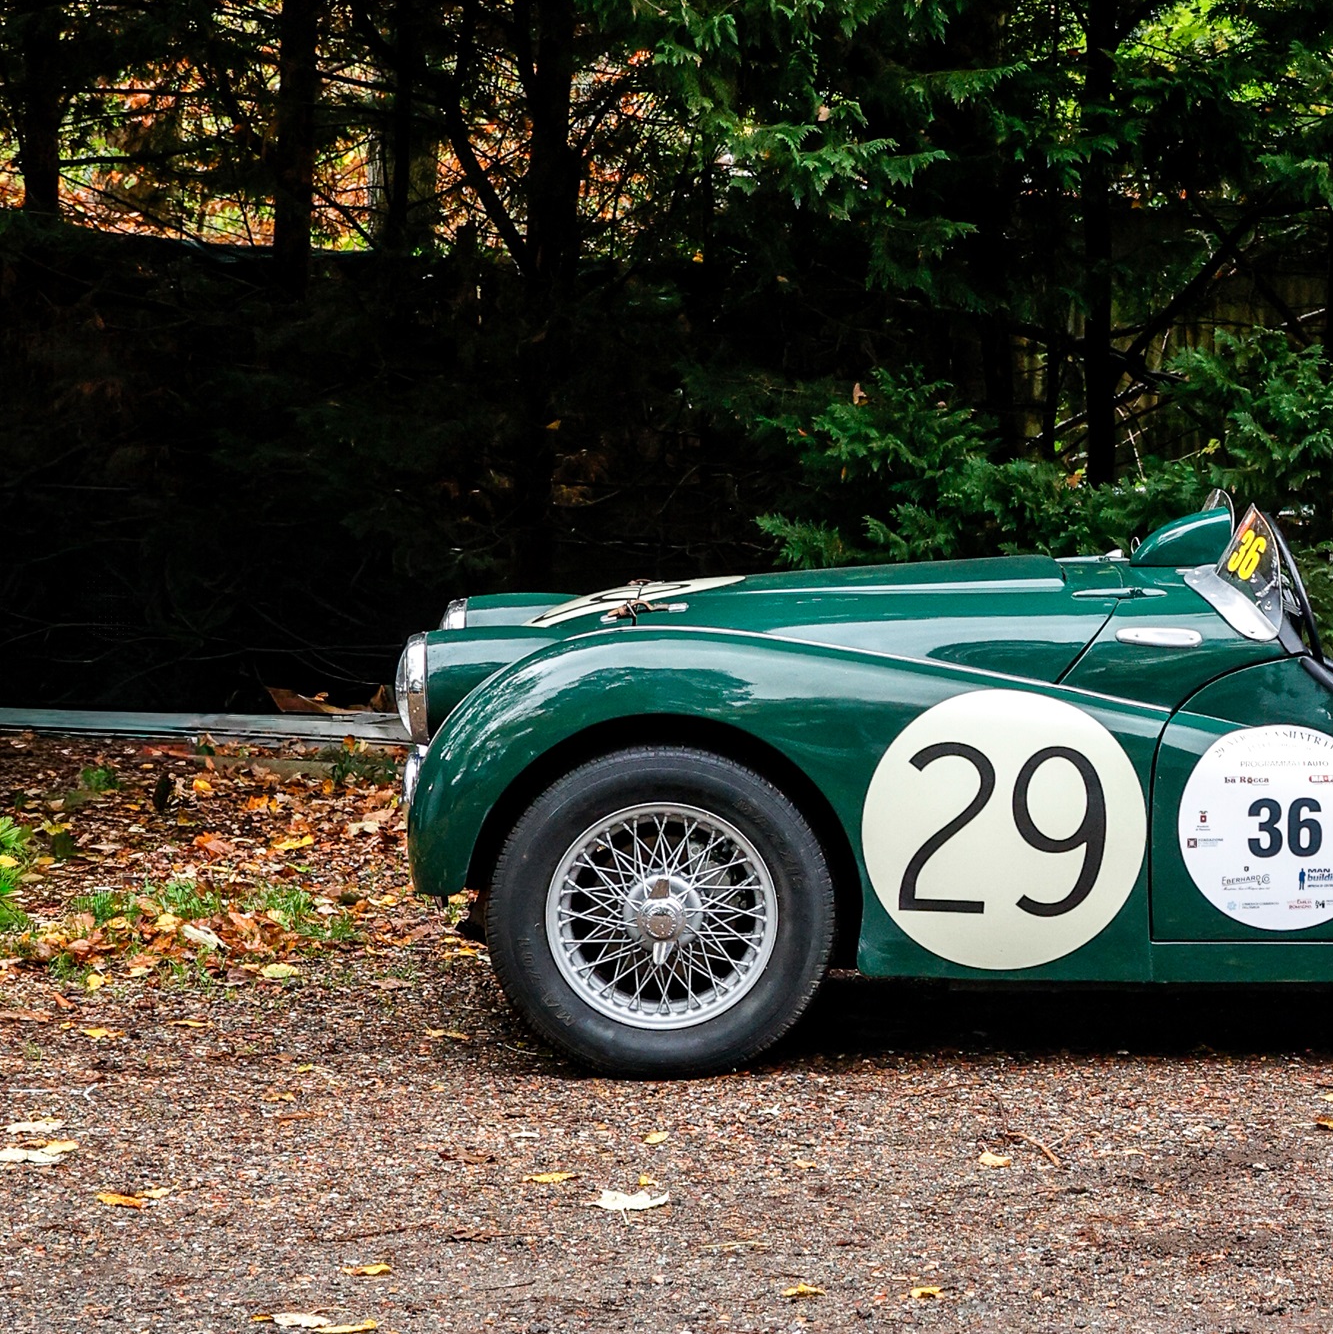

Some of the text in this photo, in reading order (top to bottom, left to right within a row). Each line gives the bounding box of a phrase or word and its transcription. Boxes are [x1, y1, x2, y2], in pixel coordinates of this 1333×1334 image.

[1227, 529, 1267, 581] 36
[899, 742, 1107, 917] 29
[1247, 797, 1323, 858] 36
[1221, 874, 1261, 887] EBERHARD
